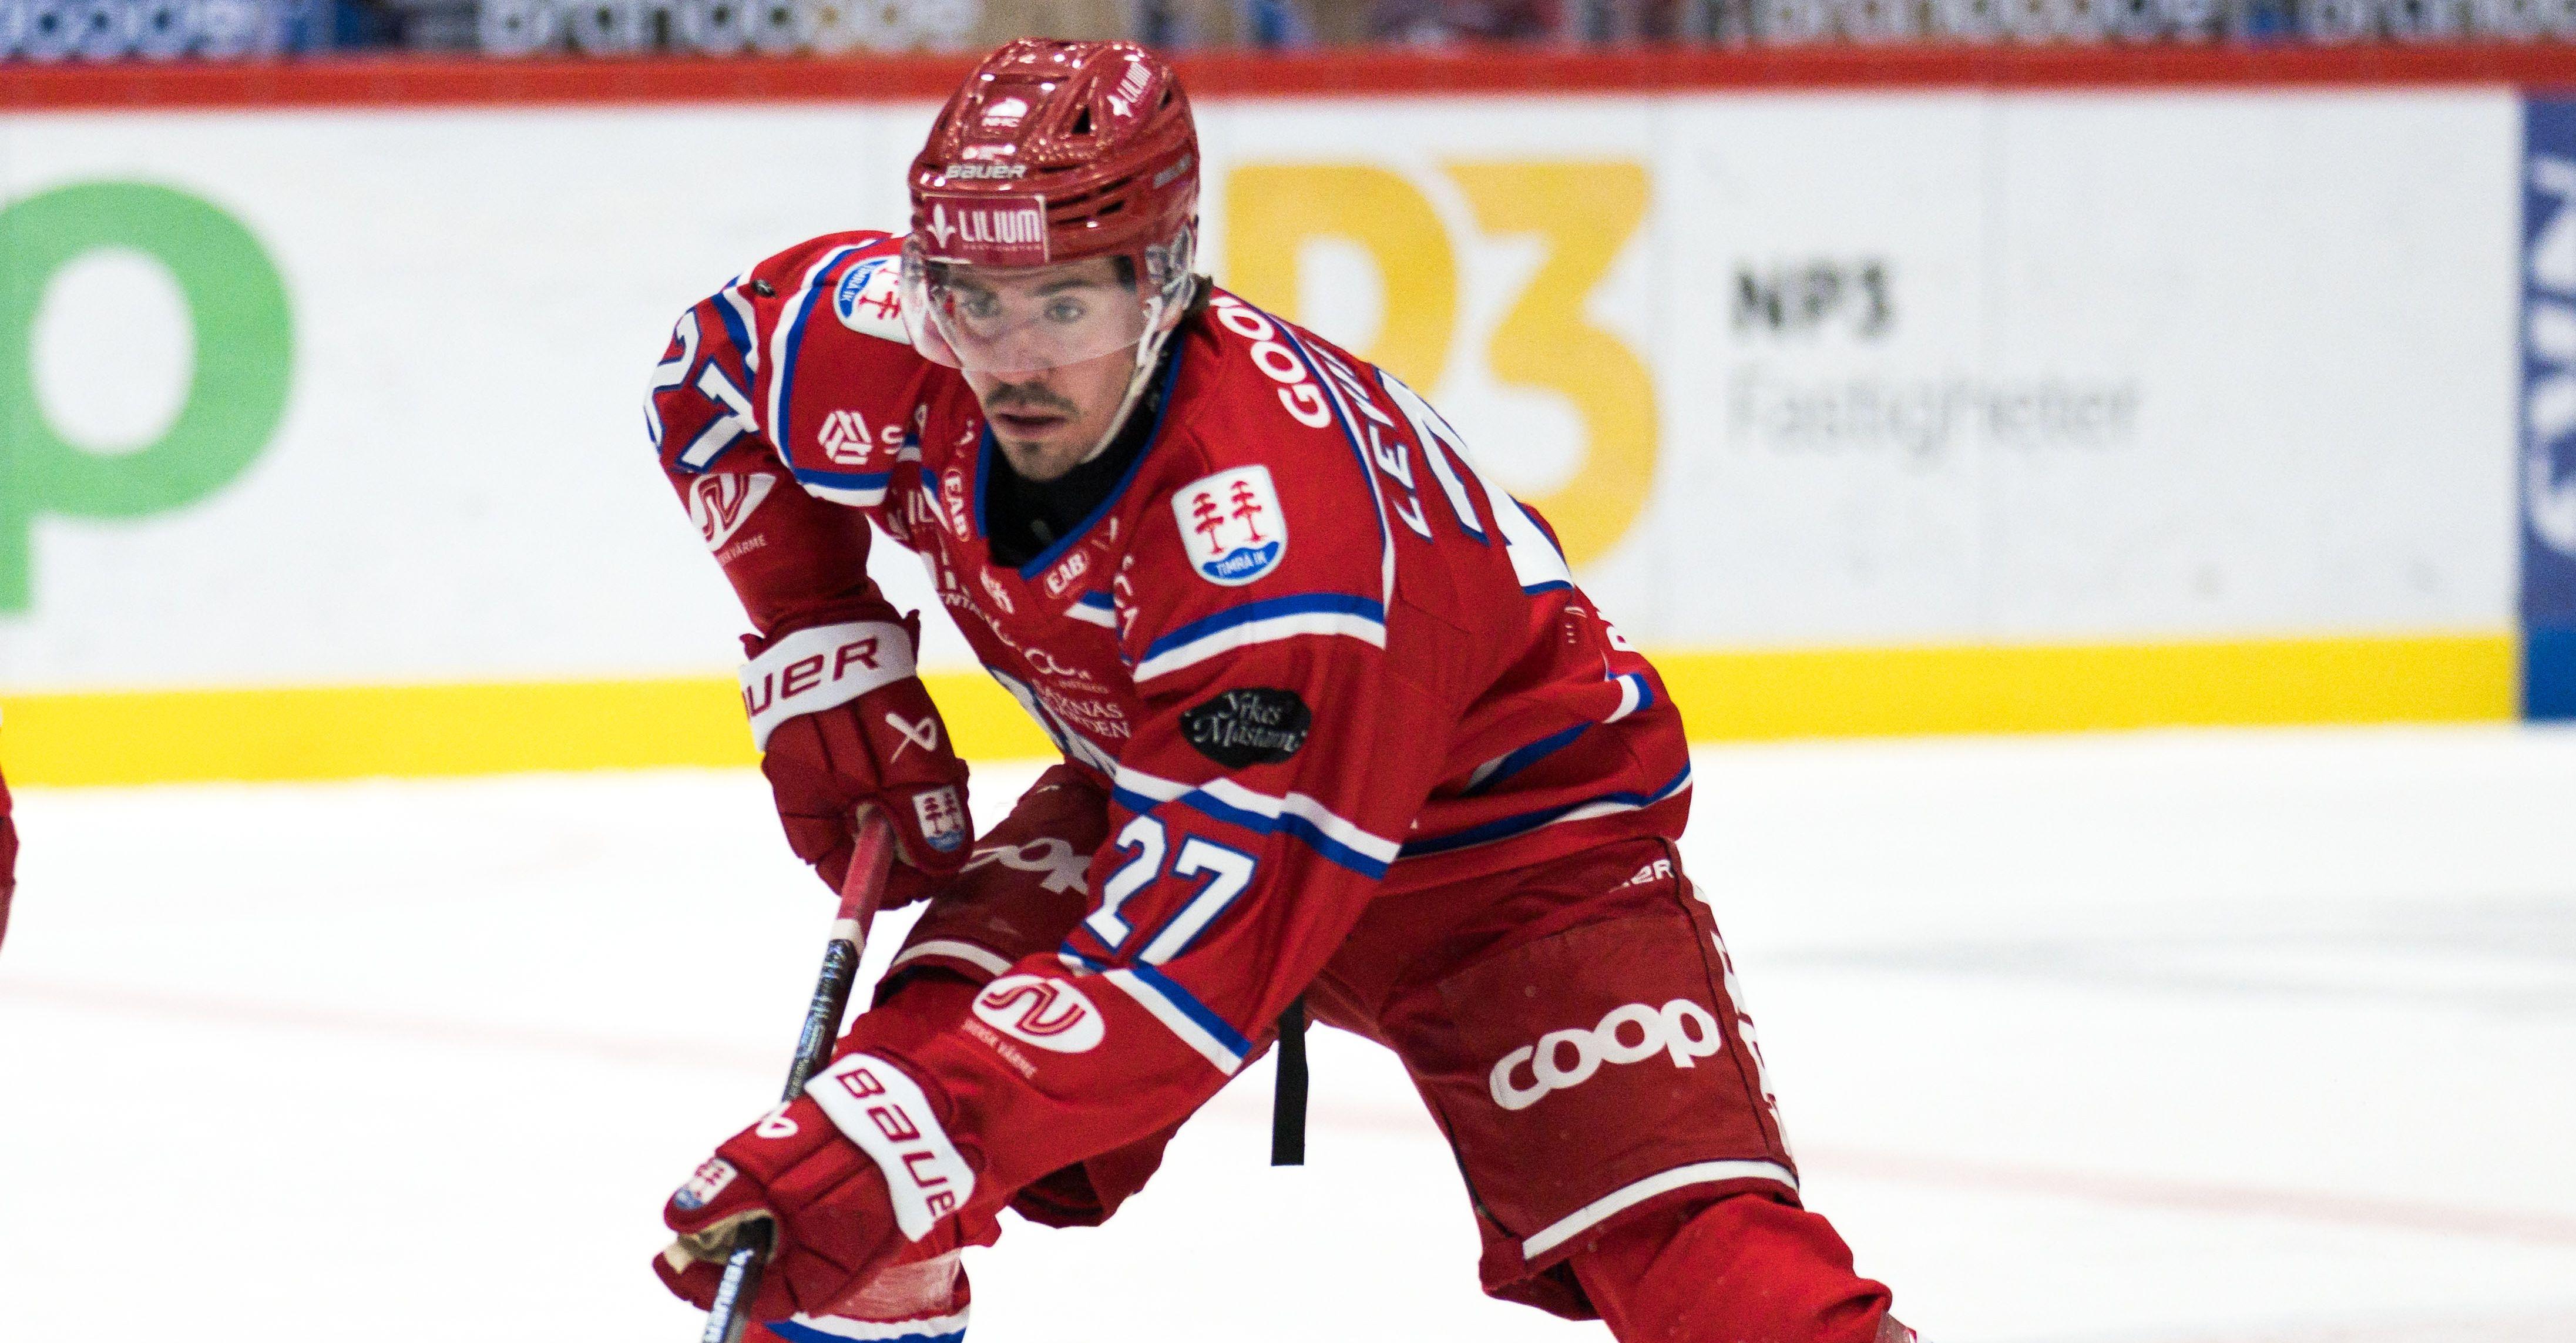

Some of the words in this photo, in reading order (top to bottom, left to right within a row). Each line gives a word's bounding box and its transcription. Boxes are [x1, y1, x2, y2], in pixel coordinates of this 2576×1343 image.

[958, 209, 1042, 244] LILIUM
[1209, 296, 1331, 429] GOO
[743, 636, 880, 720] UER
[1081, 814, 1259, 967] 27
[1489, 998, 1721, 1111] coop
[835, 1067, 956, 1218] BAUE
